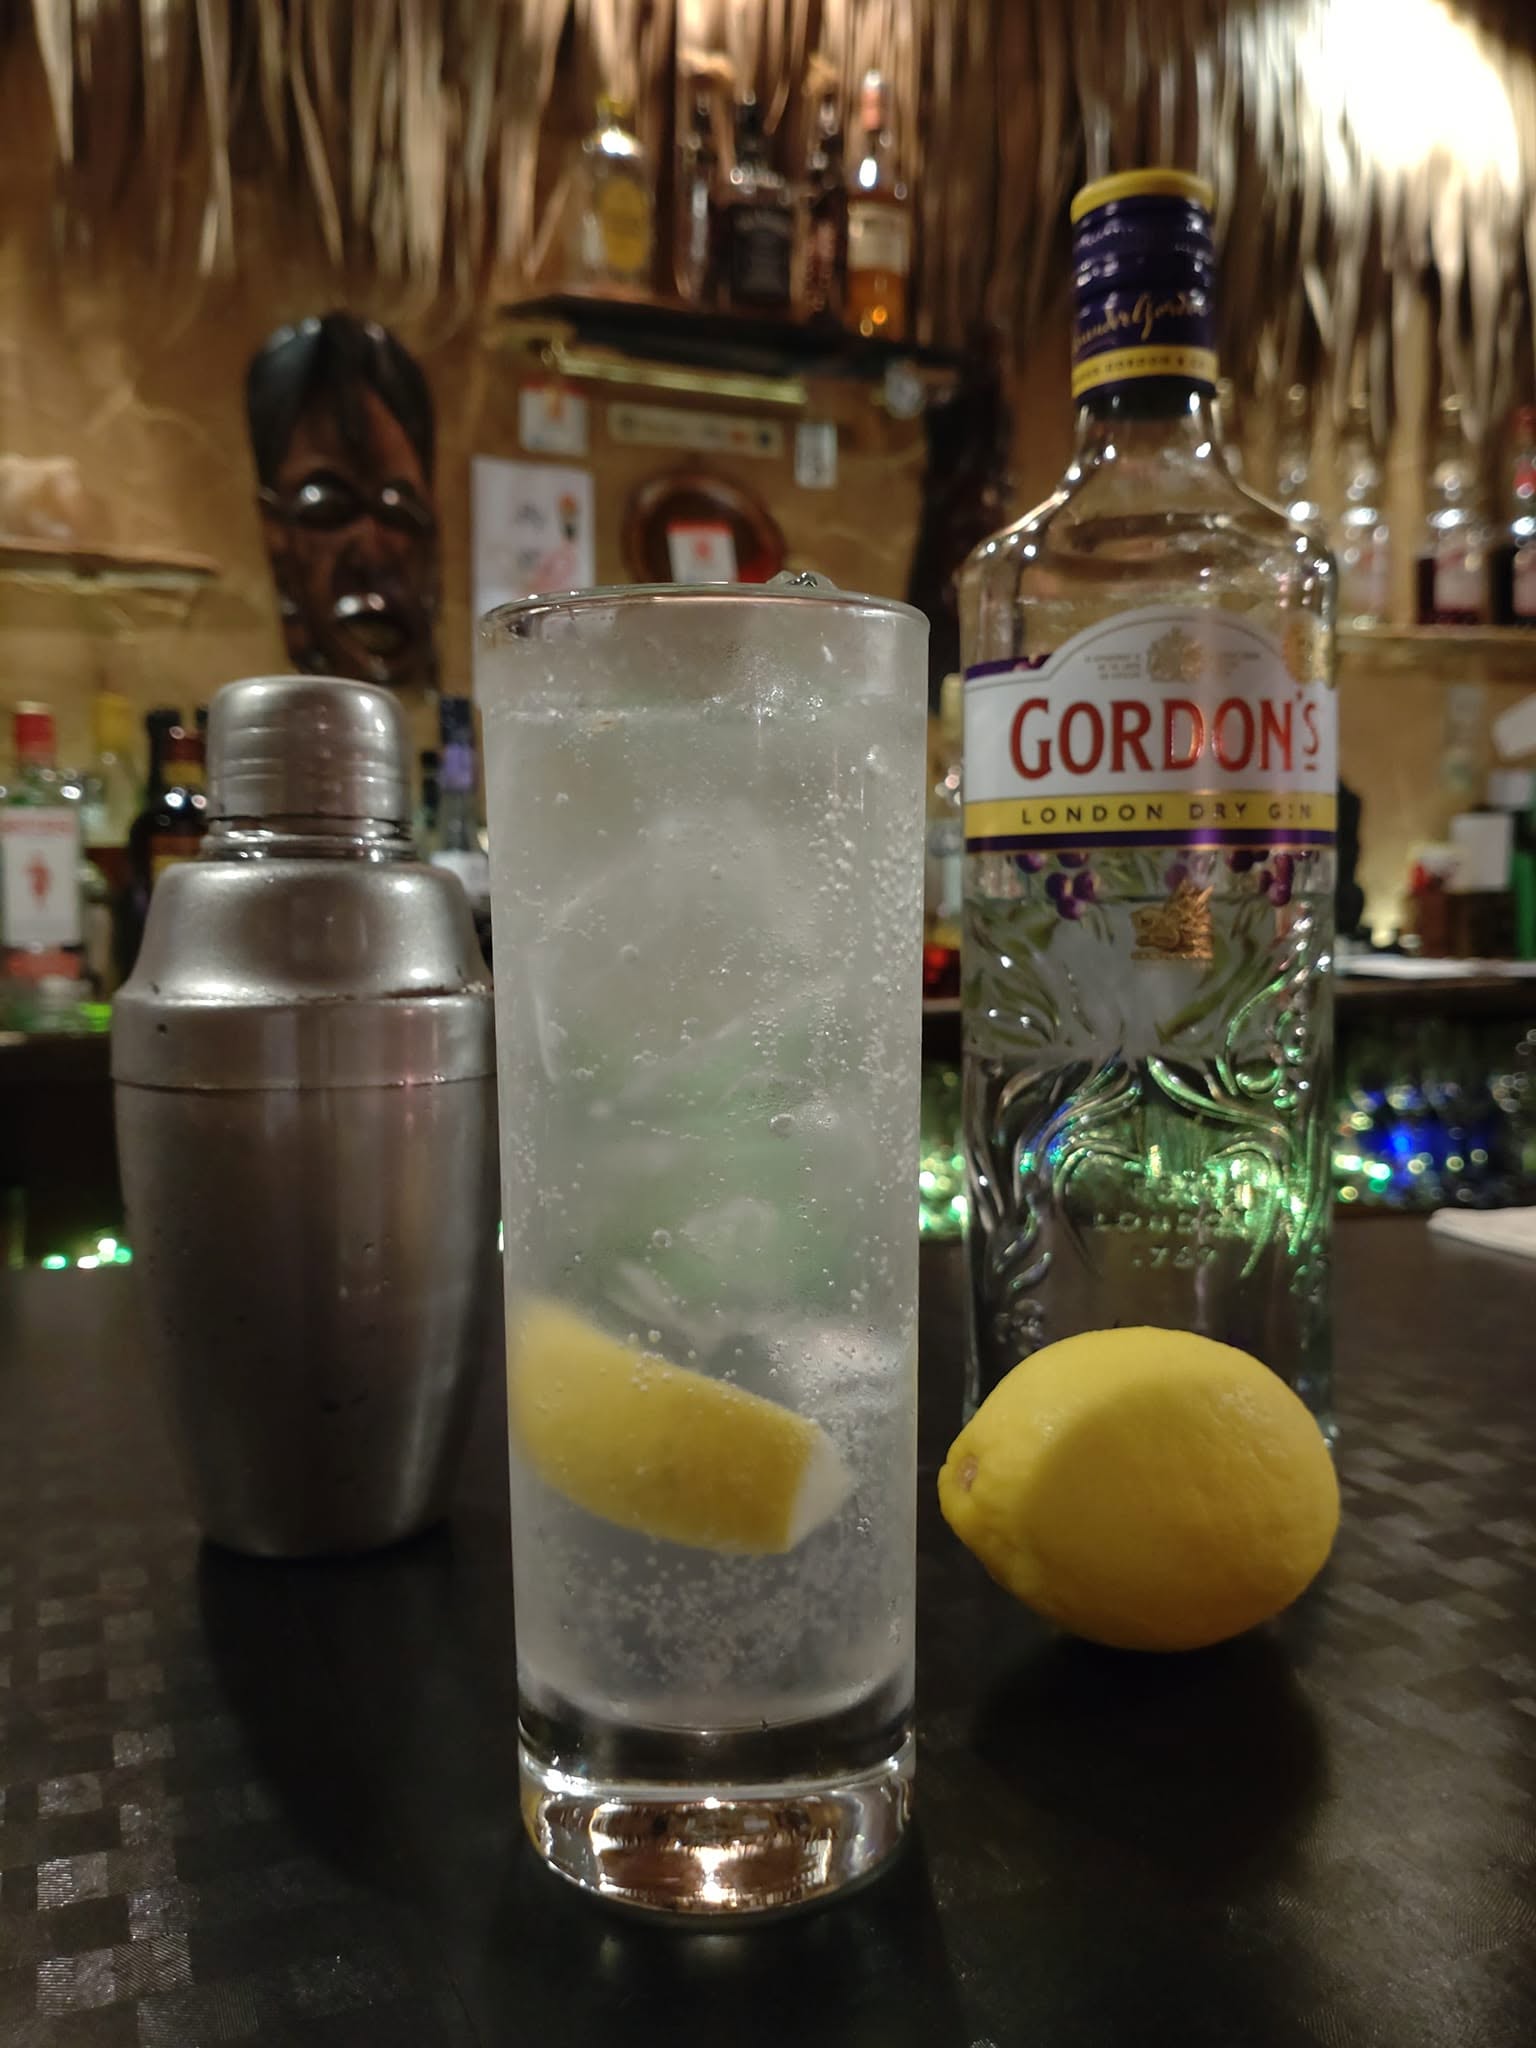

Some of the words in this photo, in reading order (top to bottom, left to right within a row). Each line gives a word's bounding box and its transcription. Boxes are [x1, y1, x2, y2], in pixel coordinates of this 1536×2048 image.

[1010, 691, 1320, 781] GORDON'S
[1021, 803, 1163, 825] LONDON
[1189, 802, 1248, 821] DRY
[1268, 803, 1312, 820] GIN
